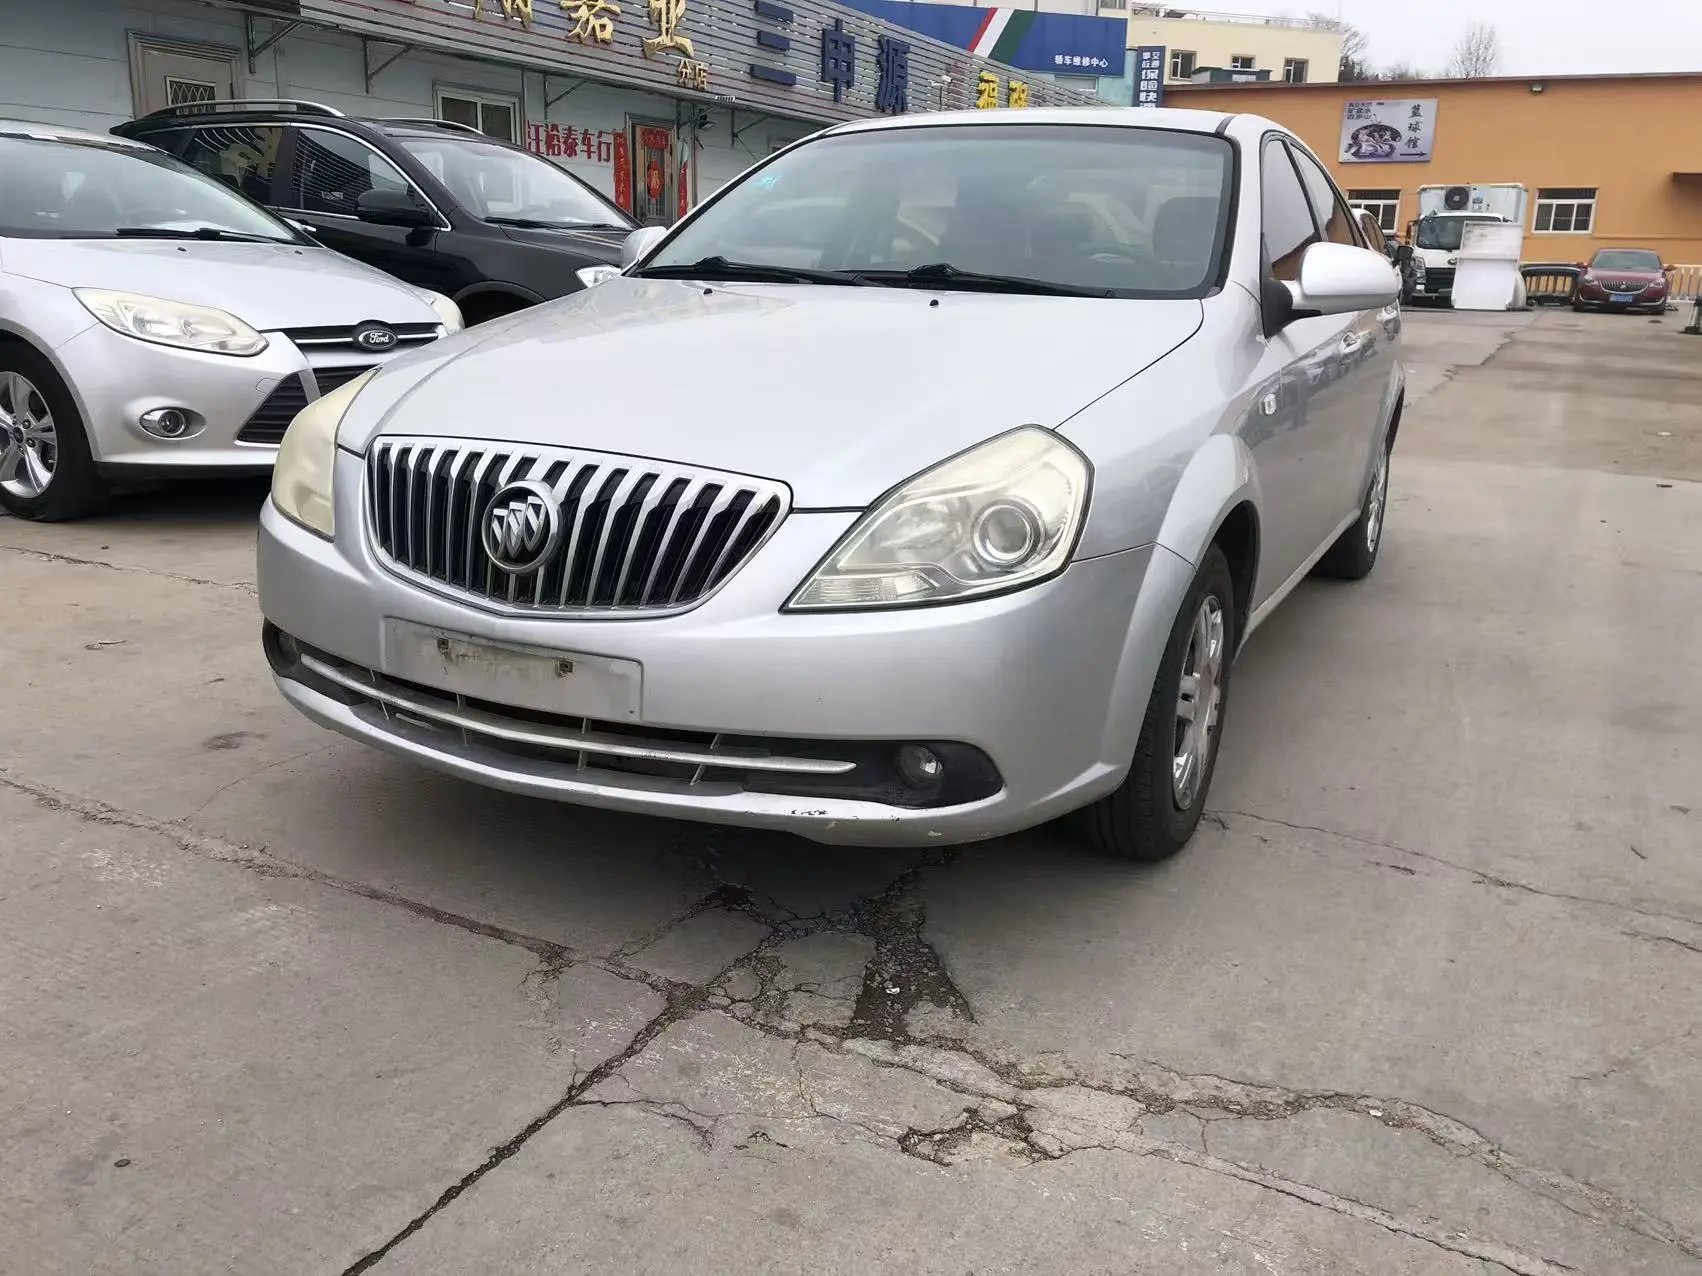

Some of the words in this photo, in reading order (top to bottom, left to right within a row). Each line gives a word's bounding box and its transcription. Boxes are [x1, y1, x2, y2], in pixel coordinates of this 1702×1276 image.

[474, 0, 695, 59] 嘉业
[750, 0, 910, 115] 三申源
[1054, 54, 1109, 68] 轿车维修中心
[676, 58, 709, 91] 分店
[369, 332, 389, 343] Ford
